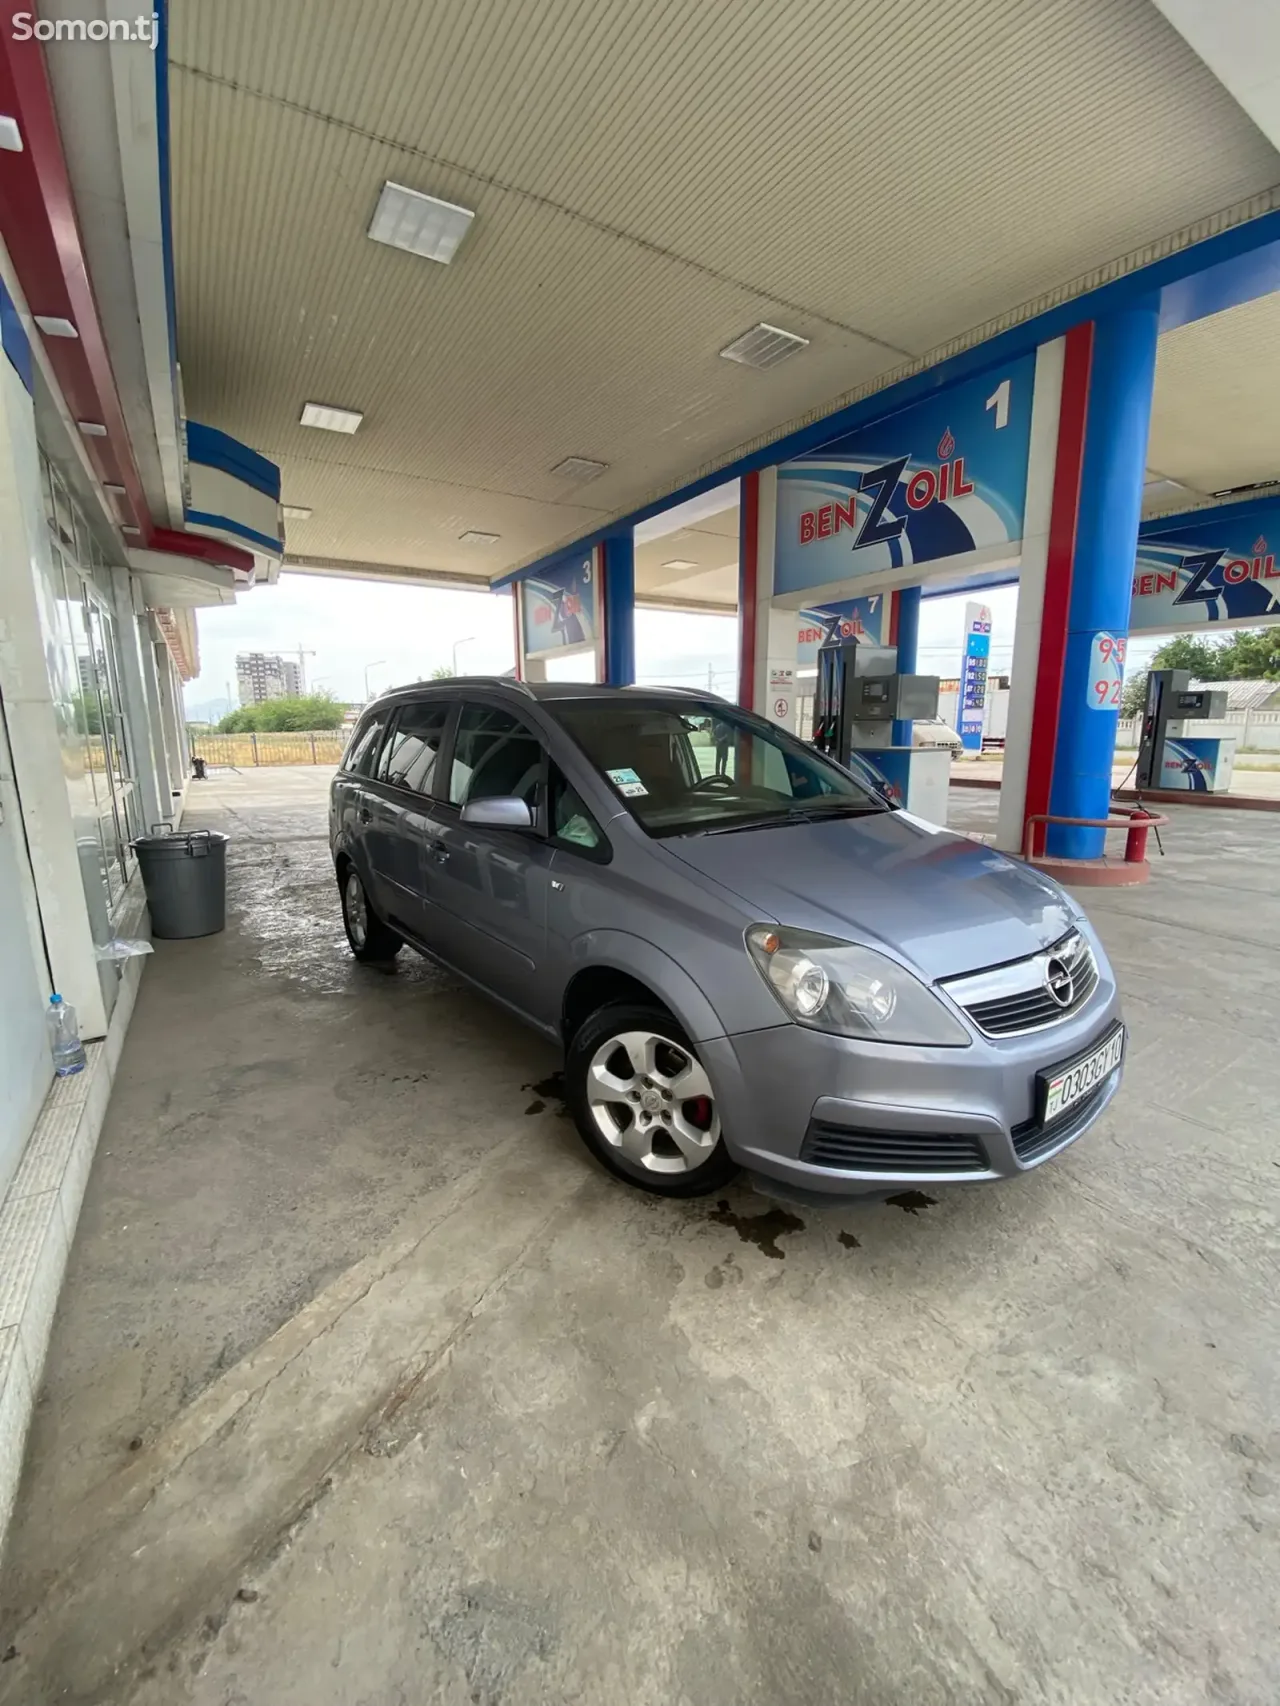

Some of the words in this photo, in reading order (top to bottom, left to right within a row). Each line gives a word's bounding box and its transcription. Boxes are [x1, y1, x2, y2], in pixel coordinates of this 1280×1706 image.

[985, 379, 1011, 430] 1
[582, 560, 592, 584] 3
[867, 595, 880, 614] 7
[1098, 637, 1126, 664] 95
[1094, 680, 1121, 705] 92
